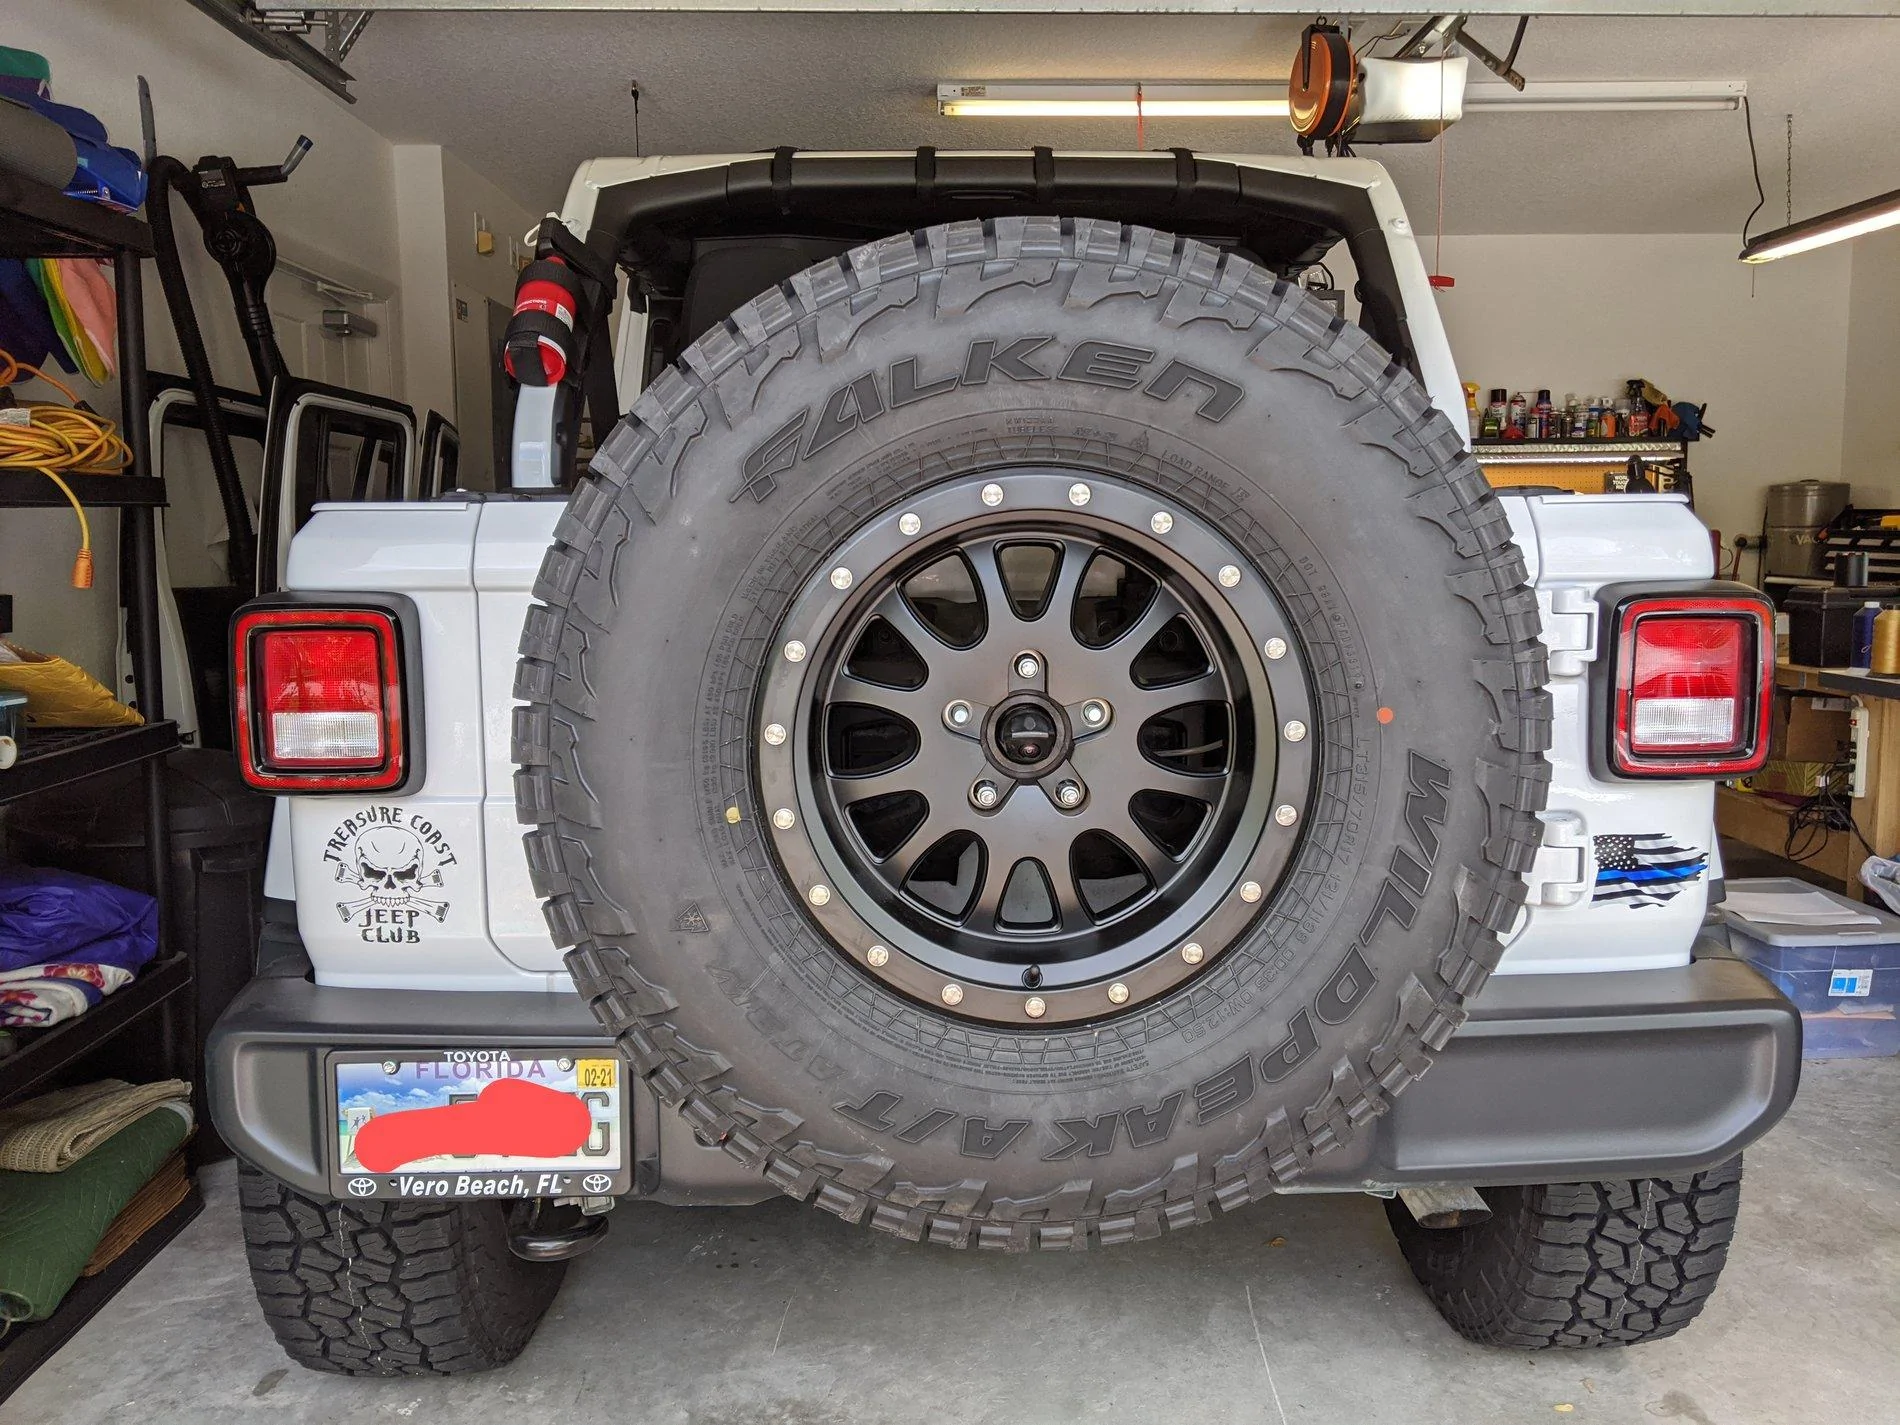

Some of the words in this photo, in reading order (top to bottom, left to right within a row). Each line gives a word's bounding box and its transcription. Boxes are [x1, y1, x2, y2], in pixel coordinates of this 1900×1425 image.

[729, 335, 1246, 503] FALKEN
[323, 804, 403, 862] TREASURE
[410, 814, 457, 867] COAST
[358, 908, 420, 929] JEEP
[361, 926, 421, 944] CLUB
[443, 1050, 512, 1063] TOYOTA
[416, 1060, 546, 1080] FLORIDA
[584, 1067, 612, 1087] 02-21
[833, 1090, 1032, 1159] A/T
[400, 1175, 448, 1196] Vero
[454, 1175, 530, 1198] Beach,
[536, 1173, 563, 1194] FL
